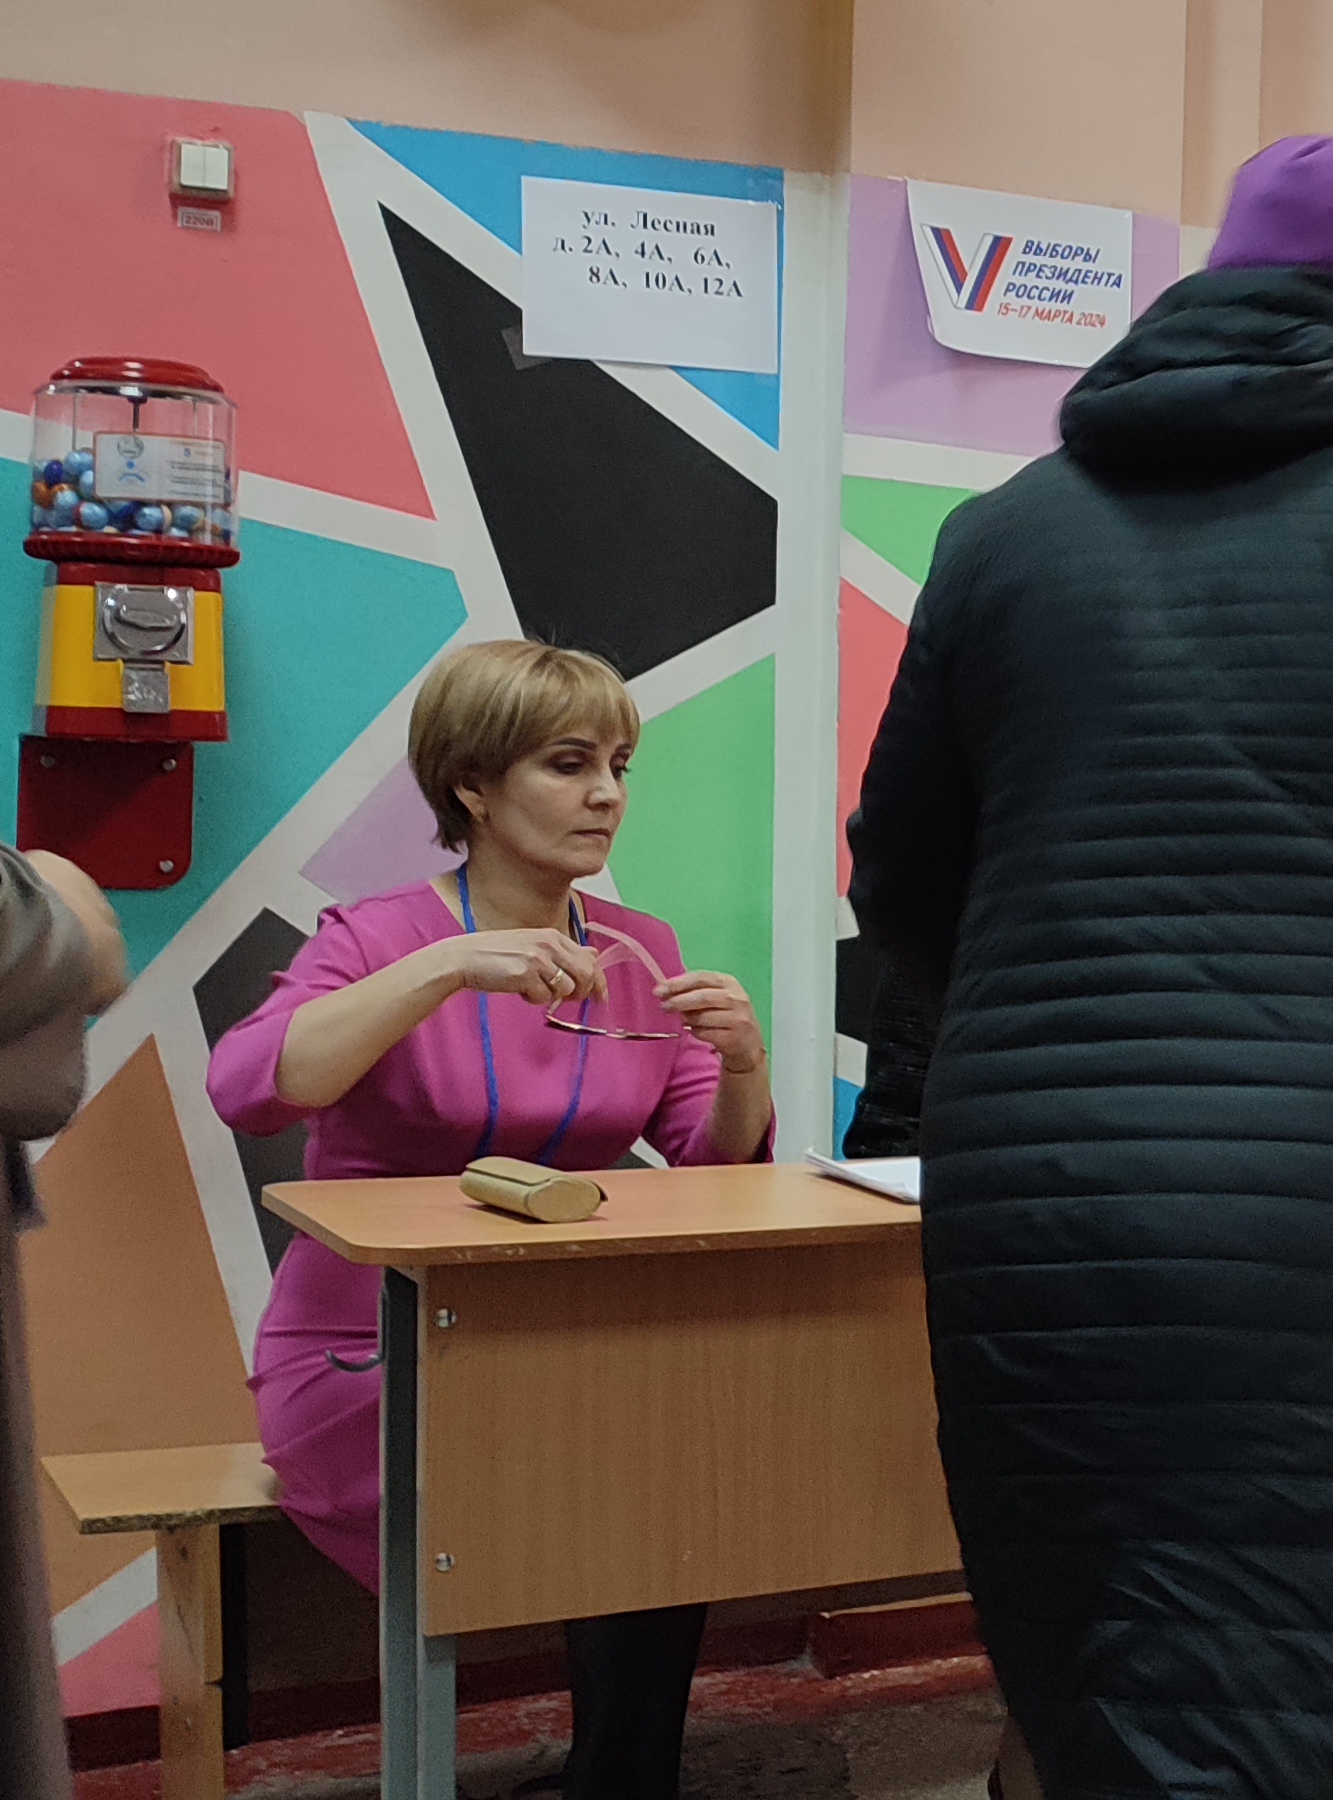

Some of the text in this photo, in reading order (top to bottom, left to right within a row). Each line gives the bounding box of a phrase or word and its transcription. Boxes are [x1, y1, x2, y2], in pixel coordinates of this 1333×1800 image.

[581, 210, 716, 237] ул. Лесная
[553, 236, 731, 270] д. 2А, 4А, 6А,
[1021, 239, 1101, 264] ВЫБОРЫ
[588, 265, 744, 298] 8А, 10А, 12А
[1012, 261, 1123, 289] ПРЕЗИДЕНТА
[1003, 281, 1075, 305] РОССИИ
[1032, 306, 1075, 325] МАРТА
[1076, 311, 1107, 329] 2024
